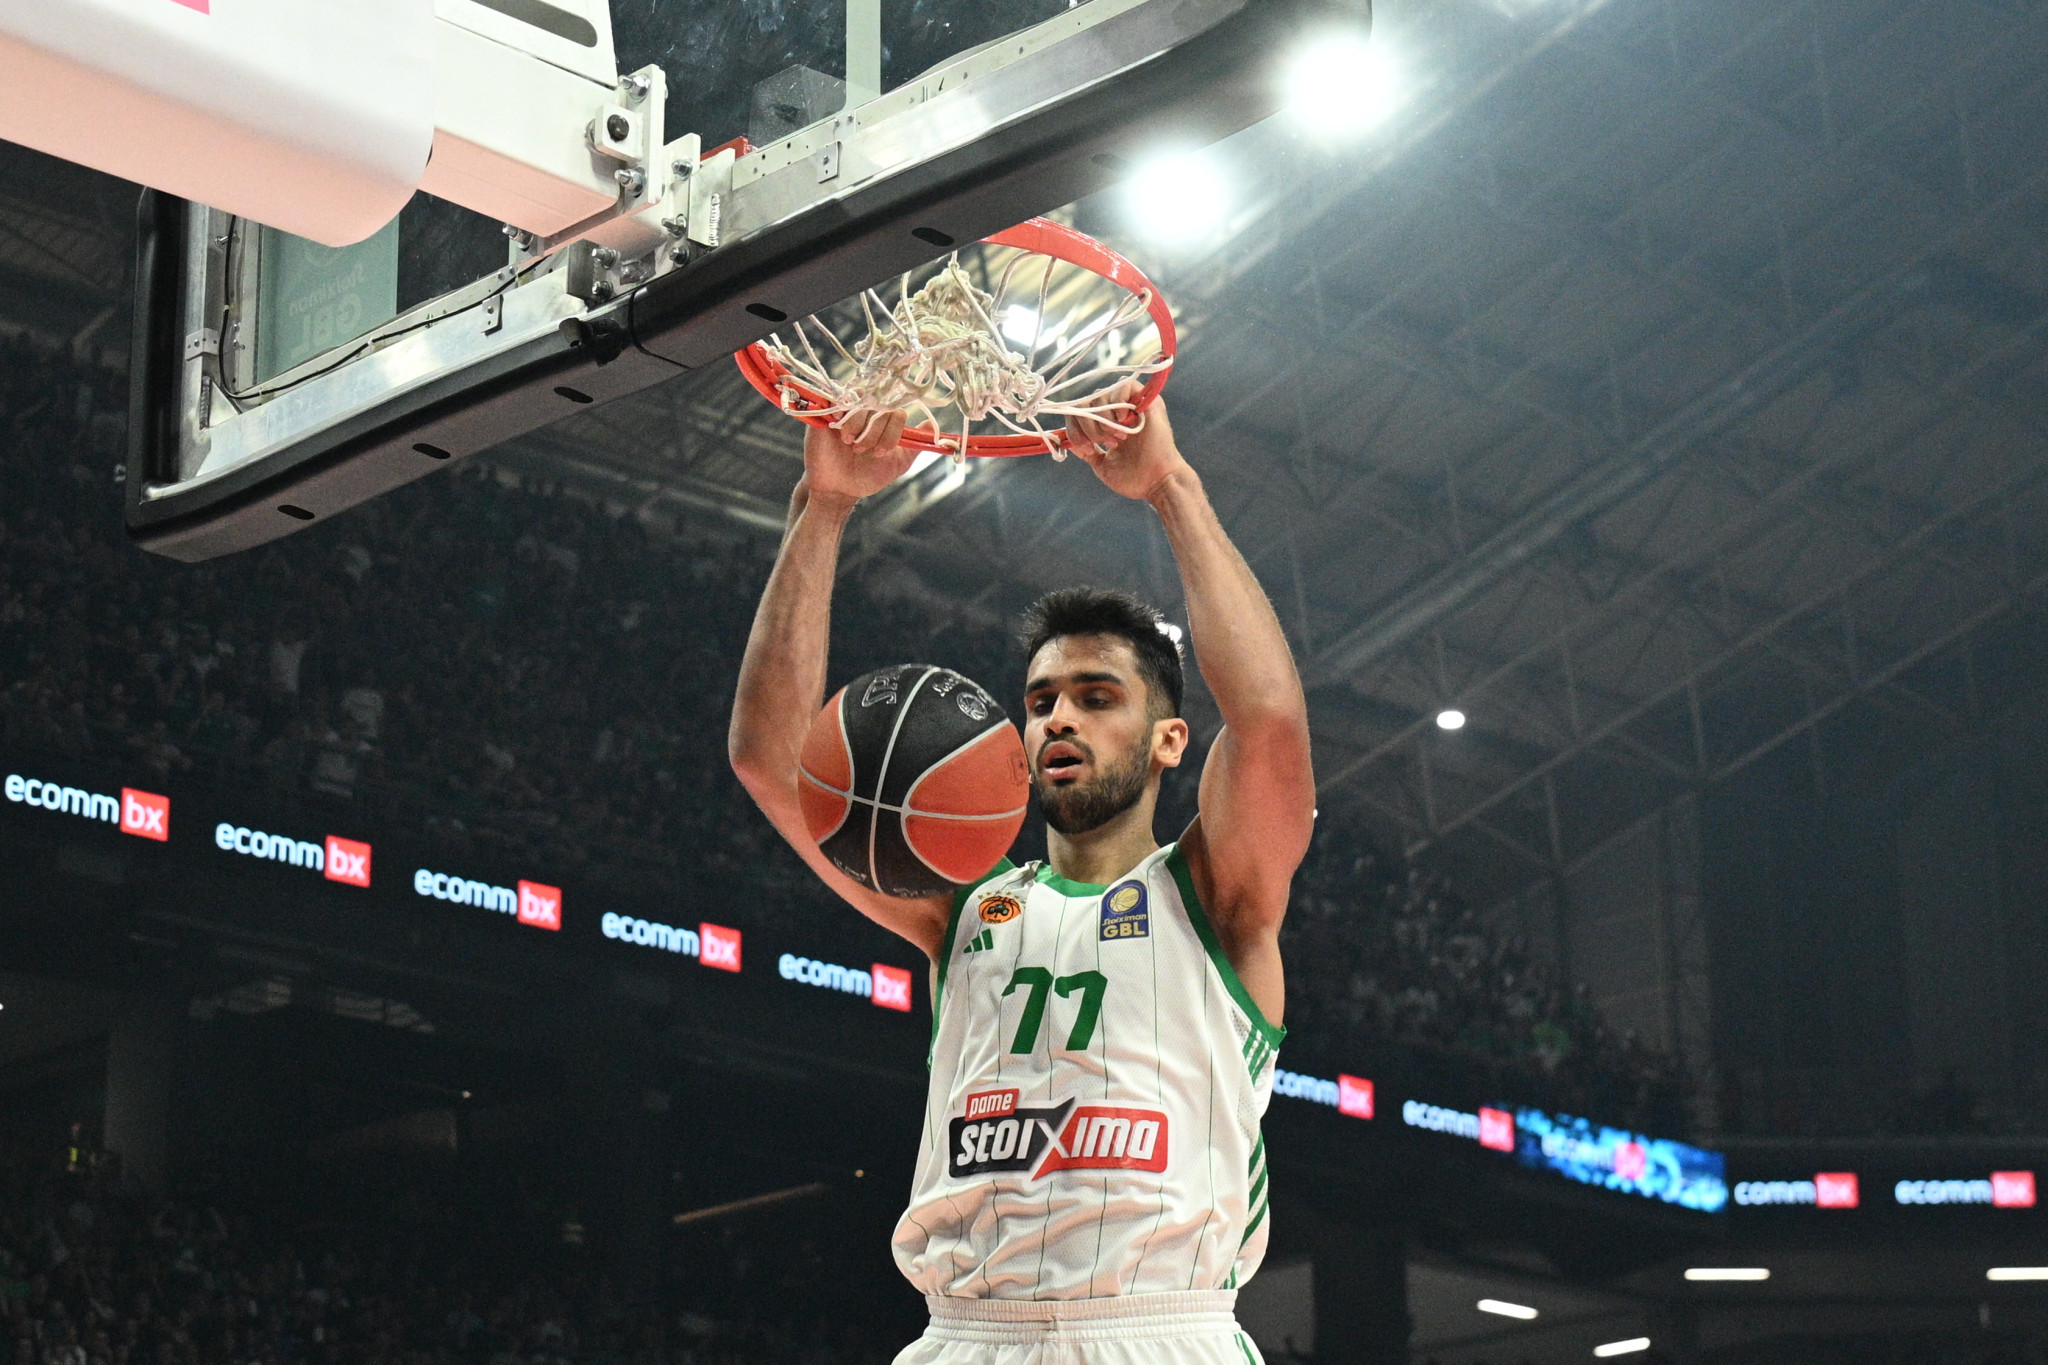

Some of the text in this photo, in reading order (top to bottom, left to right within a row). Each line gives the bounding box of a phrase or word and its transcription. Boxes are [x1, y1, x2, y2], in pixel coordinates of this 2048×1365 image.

[5, 775, 164, 834] ecommbx
[215, 823, 367, 881] ecommbx
[414, 869, 557, 924] ecommbx
[602, 912, 737, 966] ecommbx
[1103, 921, 1146, 938] GBL
[779, 953, 908, 1006] ecommbx
[1001, 967, 1108, 1054] 77
[969, 1092, 1013, 1118] pame
[1272, 1069, 1370, 1115] commbx
[1734, 1178, 1853, 1206] commbx
